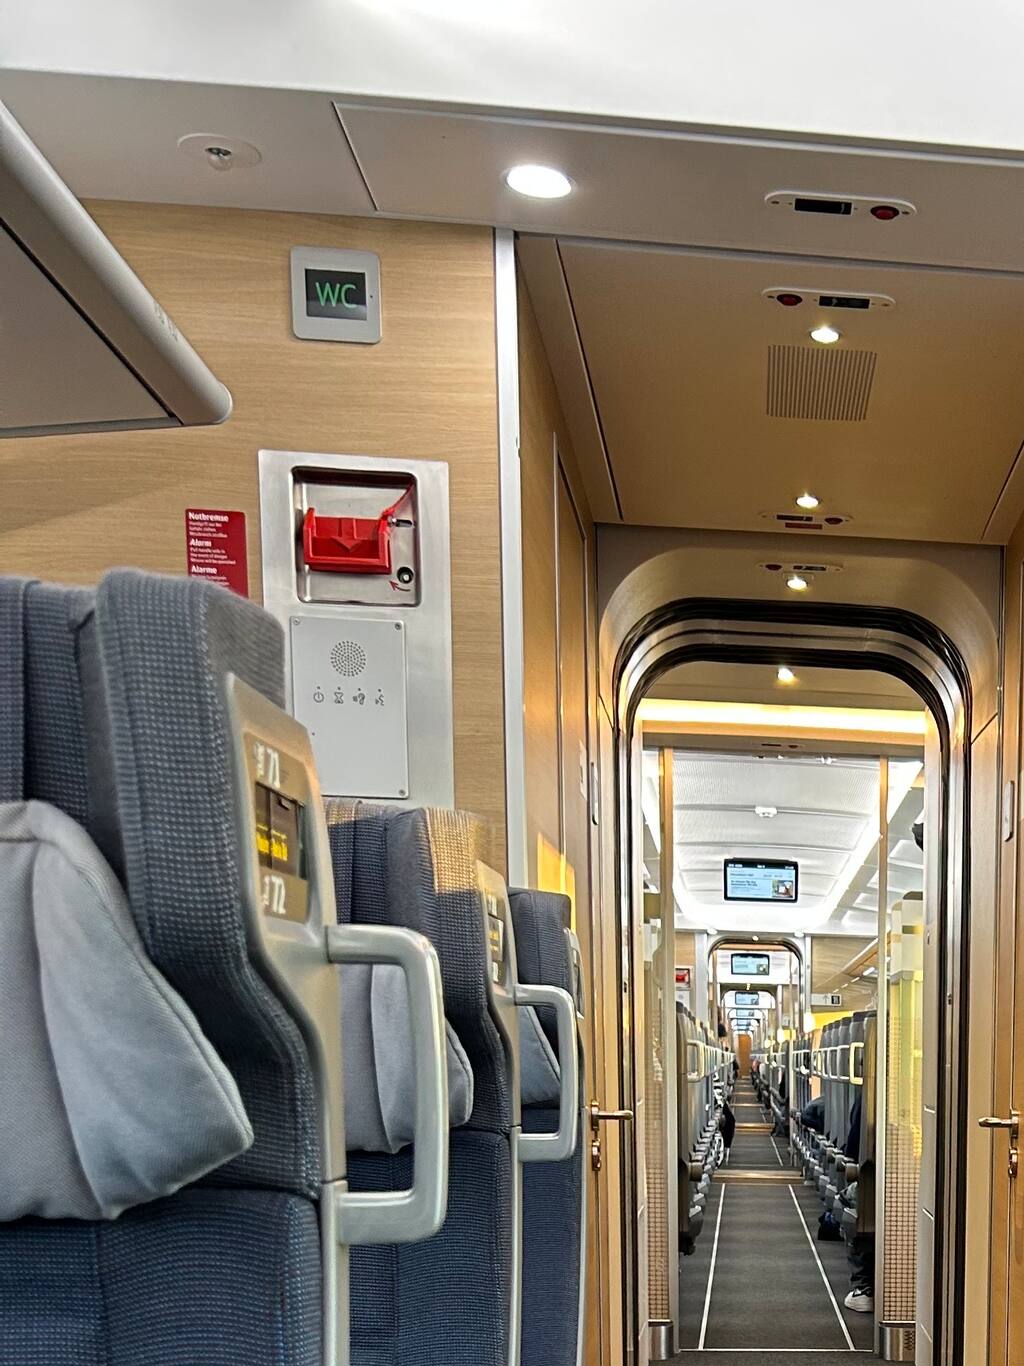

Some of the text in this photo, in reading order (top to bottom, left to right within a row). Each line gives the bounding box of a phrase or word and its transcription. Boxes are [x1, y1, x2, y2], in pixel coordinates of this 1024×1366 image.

[315, 281, 358, 309] WC
[188, 512, 229, 522] Notbremse
[189, 538, 212, 548] Alarm
[191, 565, 217, 575] Alarme
[271, 875, 287, 915] 72
